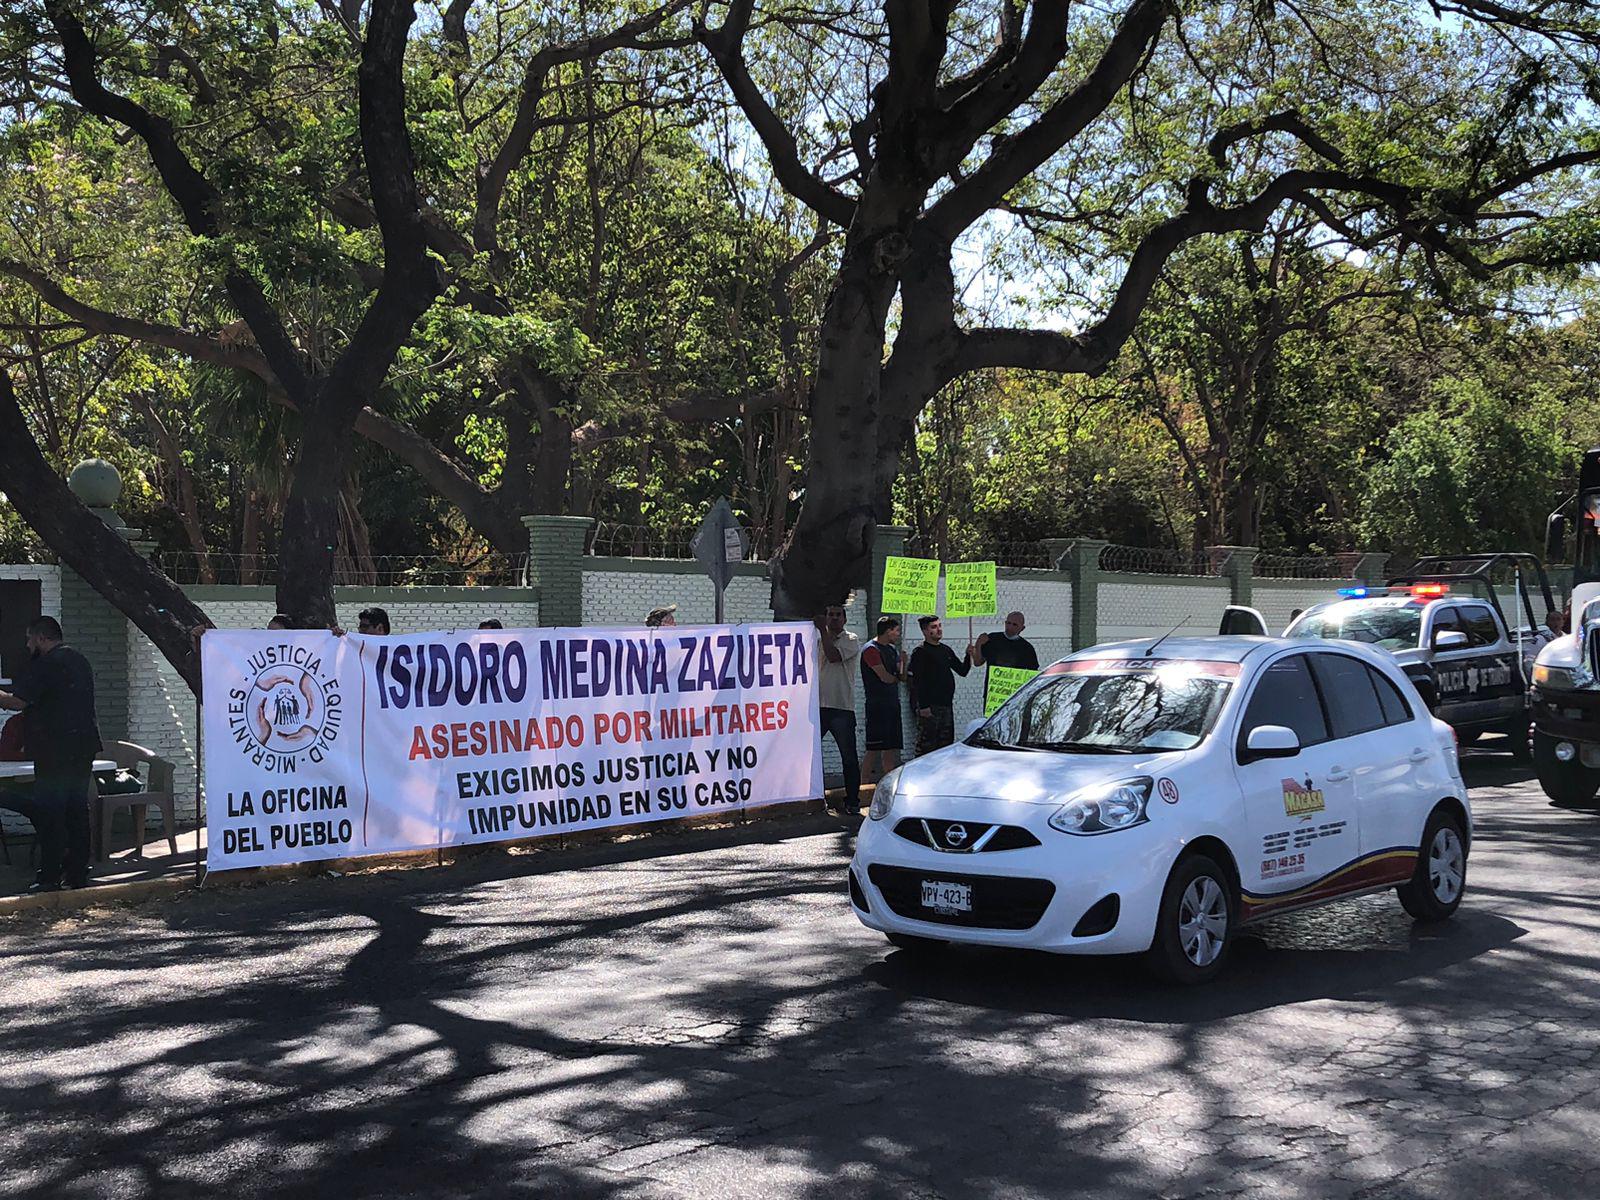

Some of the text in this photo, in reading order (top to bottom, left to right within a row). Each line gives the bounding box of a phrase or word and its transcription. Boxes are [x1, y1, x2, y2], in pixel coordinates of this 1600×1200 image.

[248, 644, 321, 675] JUSTICIA
[375, 633, 808, 709] ISIDORO MEDINA ZAZUETA
[228, 687, 296, 774] MIGRANTES
[309, 678, 342, 764] EQUIDAD
[408, 700, 789, 761] ASESINADO POR MILITARES
[456, 746, 758, 799] EXIGIMOS JUSTICIA Y NO
[1161, 780, 1176, 800] 48
[227, 785, 348, 817] LA OFICINA
[468, 778, 752, 835] IMPUNIDAD EN SU CASO
[223, 819, 352, 854] DEL PUEBLO
